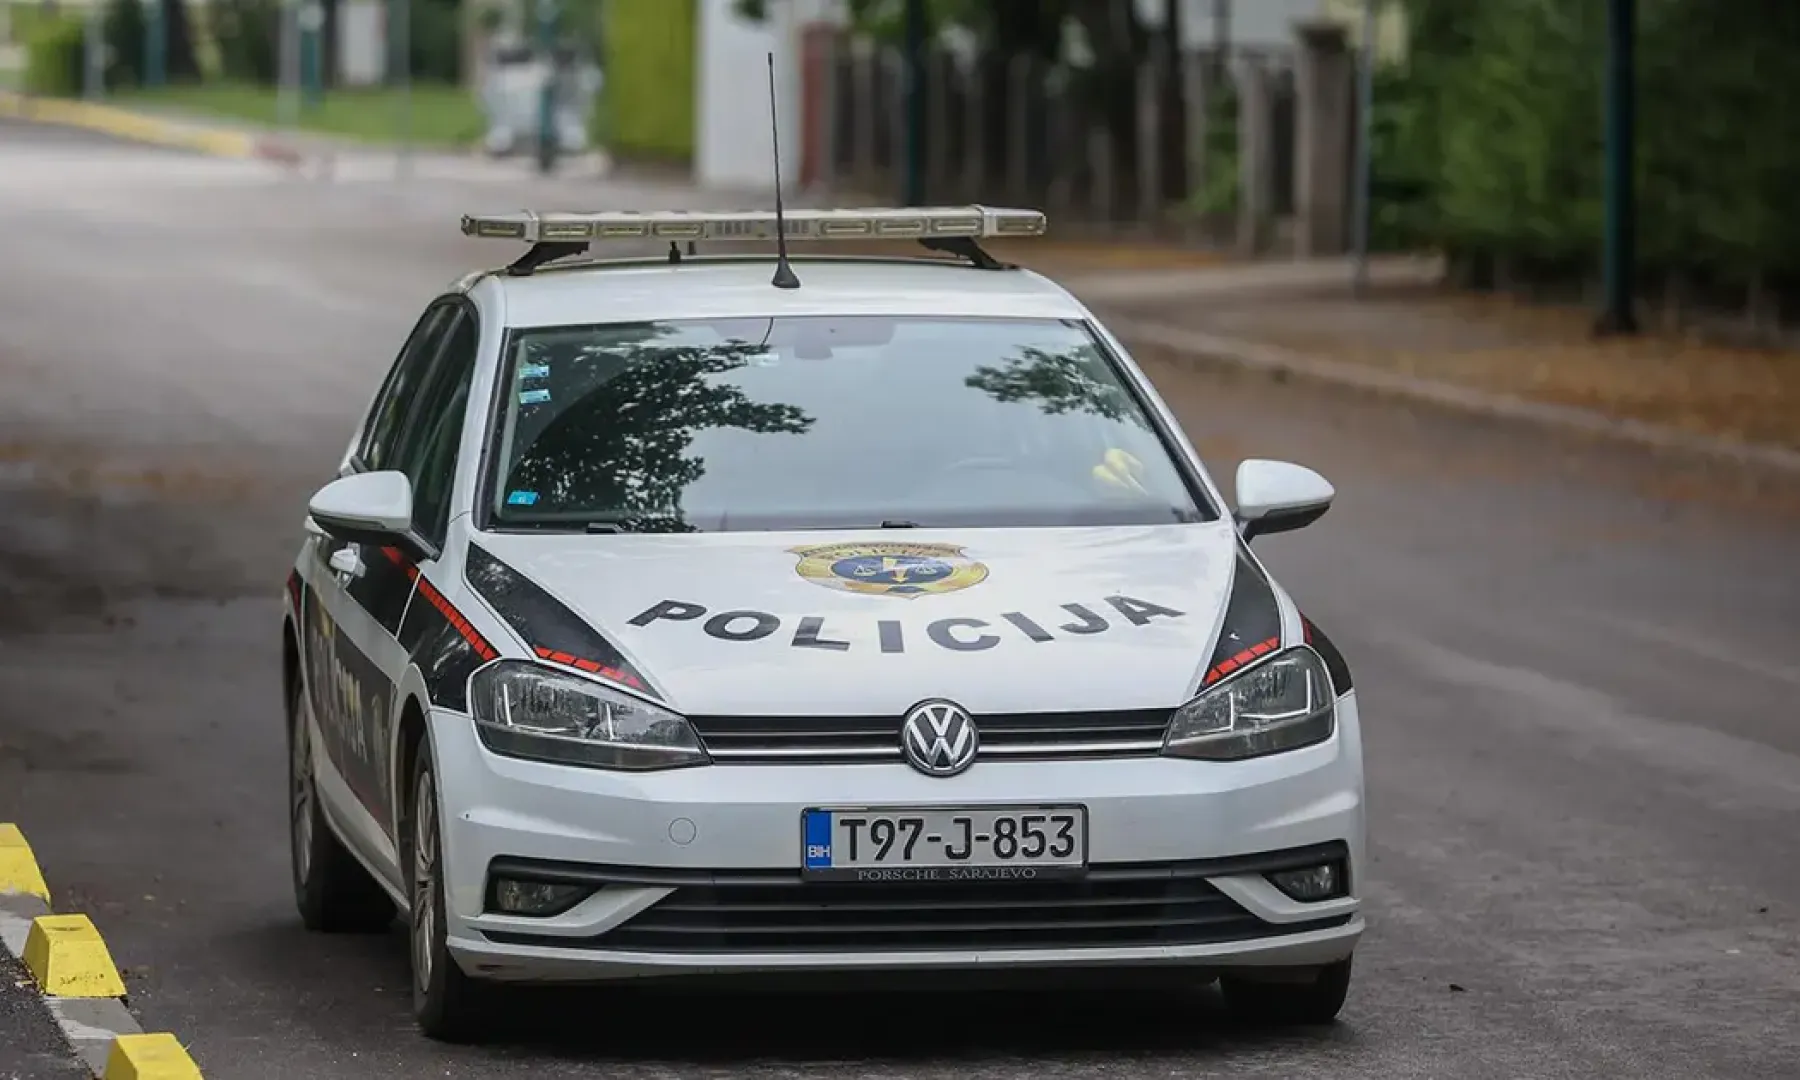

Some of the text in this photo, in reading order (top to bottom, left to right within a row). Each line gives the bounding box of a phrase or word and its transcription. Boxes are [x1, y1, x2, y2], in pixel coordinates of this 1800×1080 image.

[626, 594, 1186, 654] POLICIJA
[808, 844, 830, 858] BIH
[839, 814, 1075, 861] T97-J-853
[857, 867, 1037, 881] PORSCHE SARAJEVO
